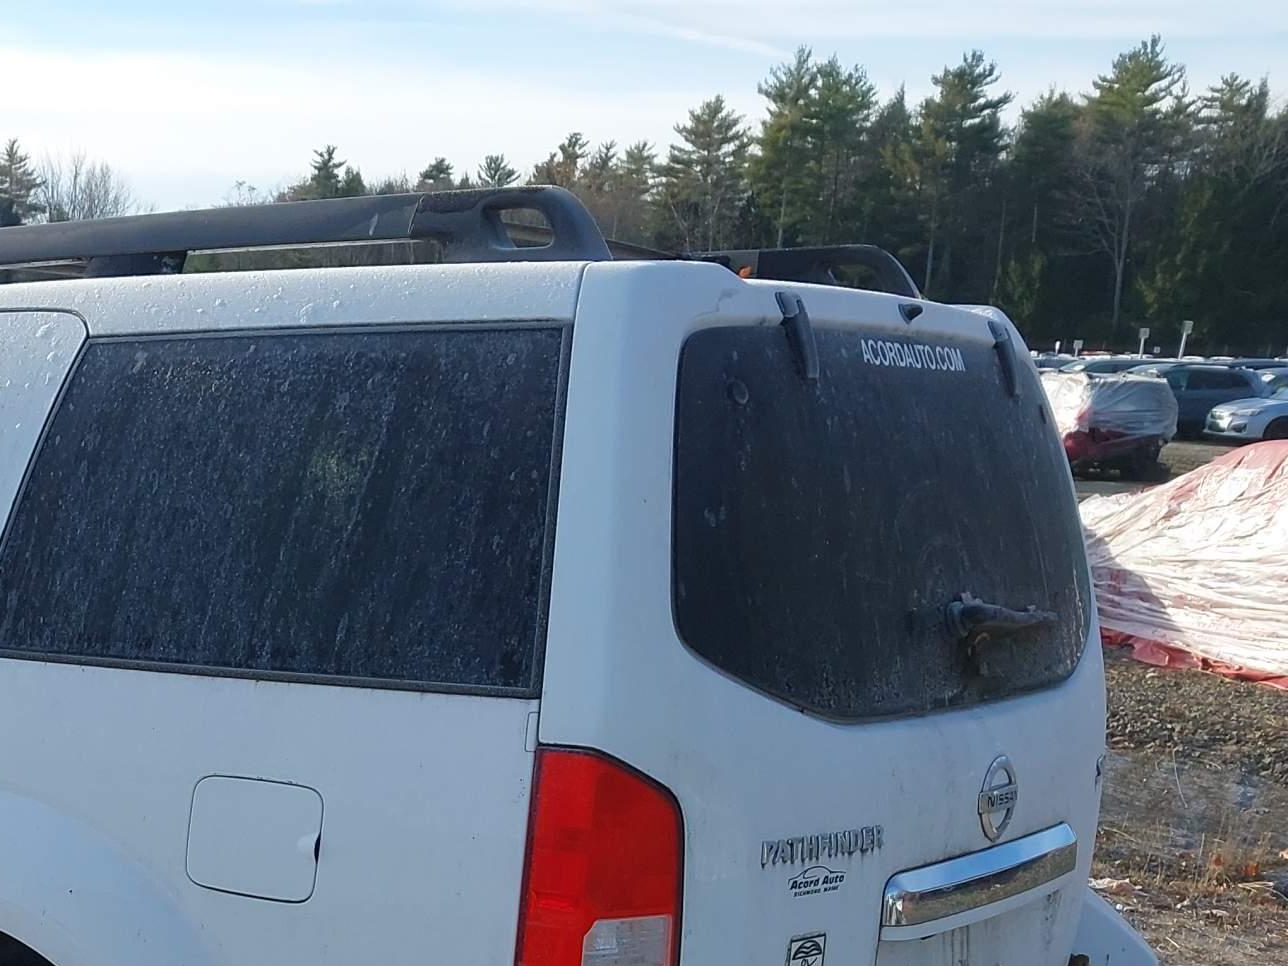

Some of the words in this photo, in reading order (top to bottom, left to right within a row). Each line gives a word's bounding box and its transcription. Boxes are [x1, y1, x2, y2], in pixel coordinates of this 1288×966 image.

[860, 338, 966, 373] ACORDAUTO.COM
[760, 824, 885, 869] PATHFINDER
[789, 877, 821, 891] Acord
[821, 874, 845, 886] Auto
